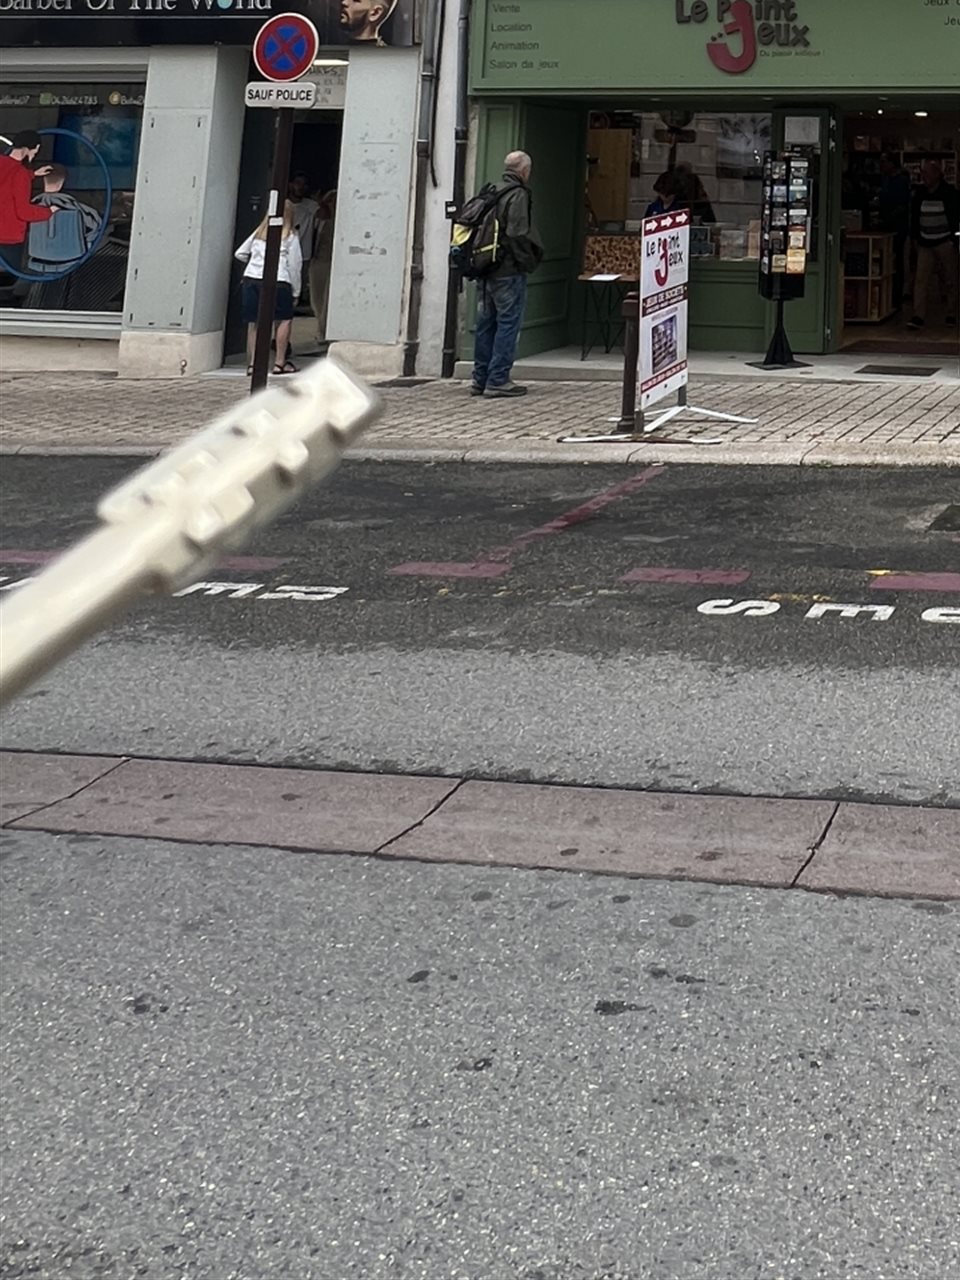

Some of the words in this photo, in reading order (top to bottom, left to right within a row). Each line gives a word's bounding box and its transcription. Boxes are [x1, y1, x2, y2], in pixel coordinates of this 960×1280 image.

[492, 3, 521, 14] Vente
[675, 0, 709, 24] Le
[491, 23, 534, 33] Location
[490, 41, 540, 51] Animation
[489, 59, 517, 70] Salon
[247, 89, 274, 100] SAUF
[276, 89, 313, 101] POLICE
